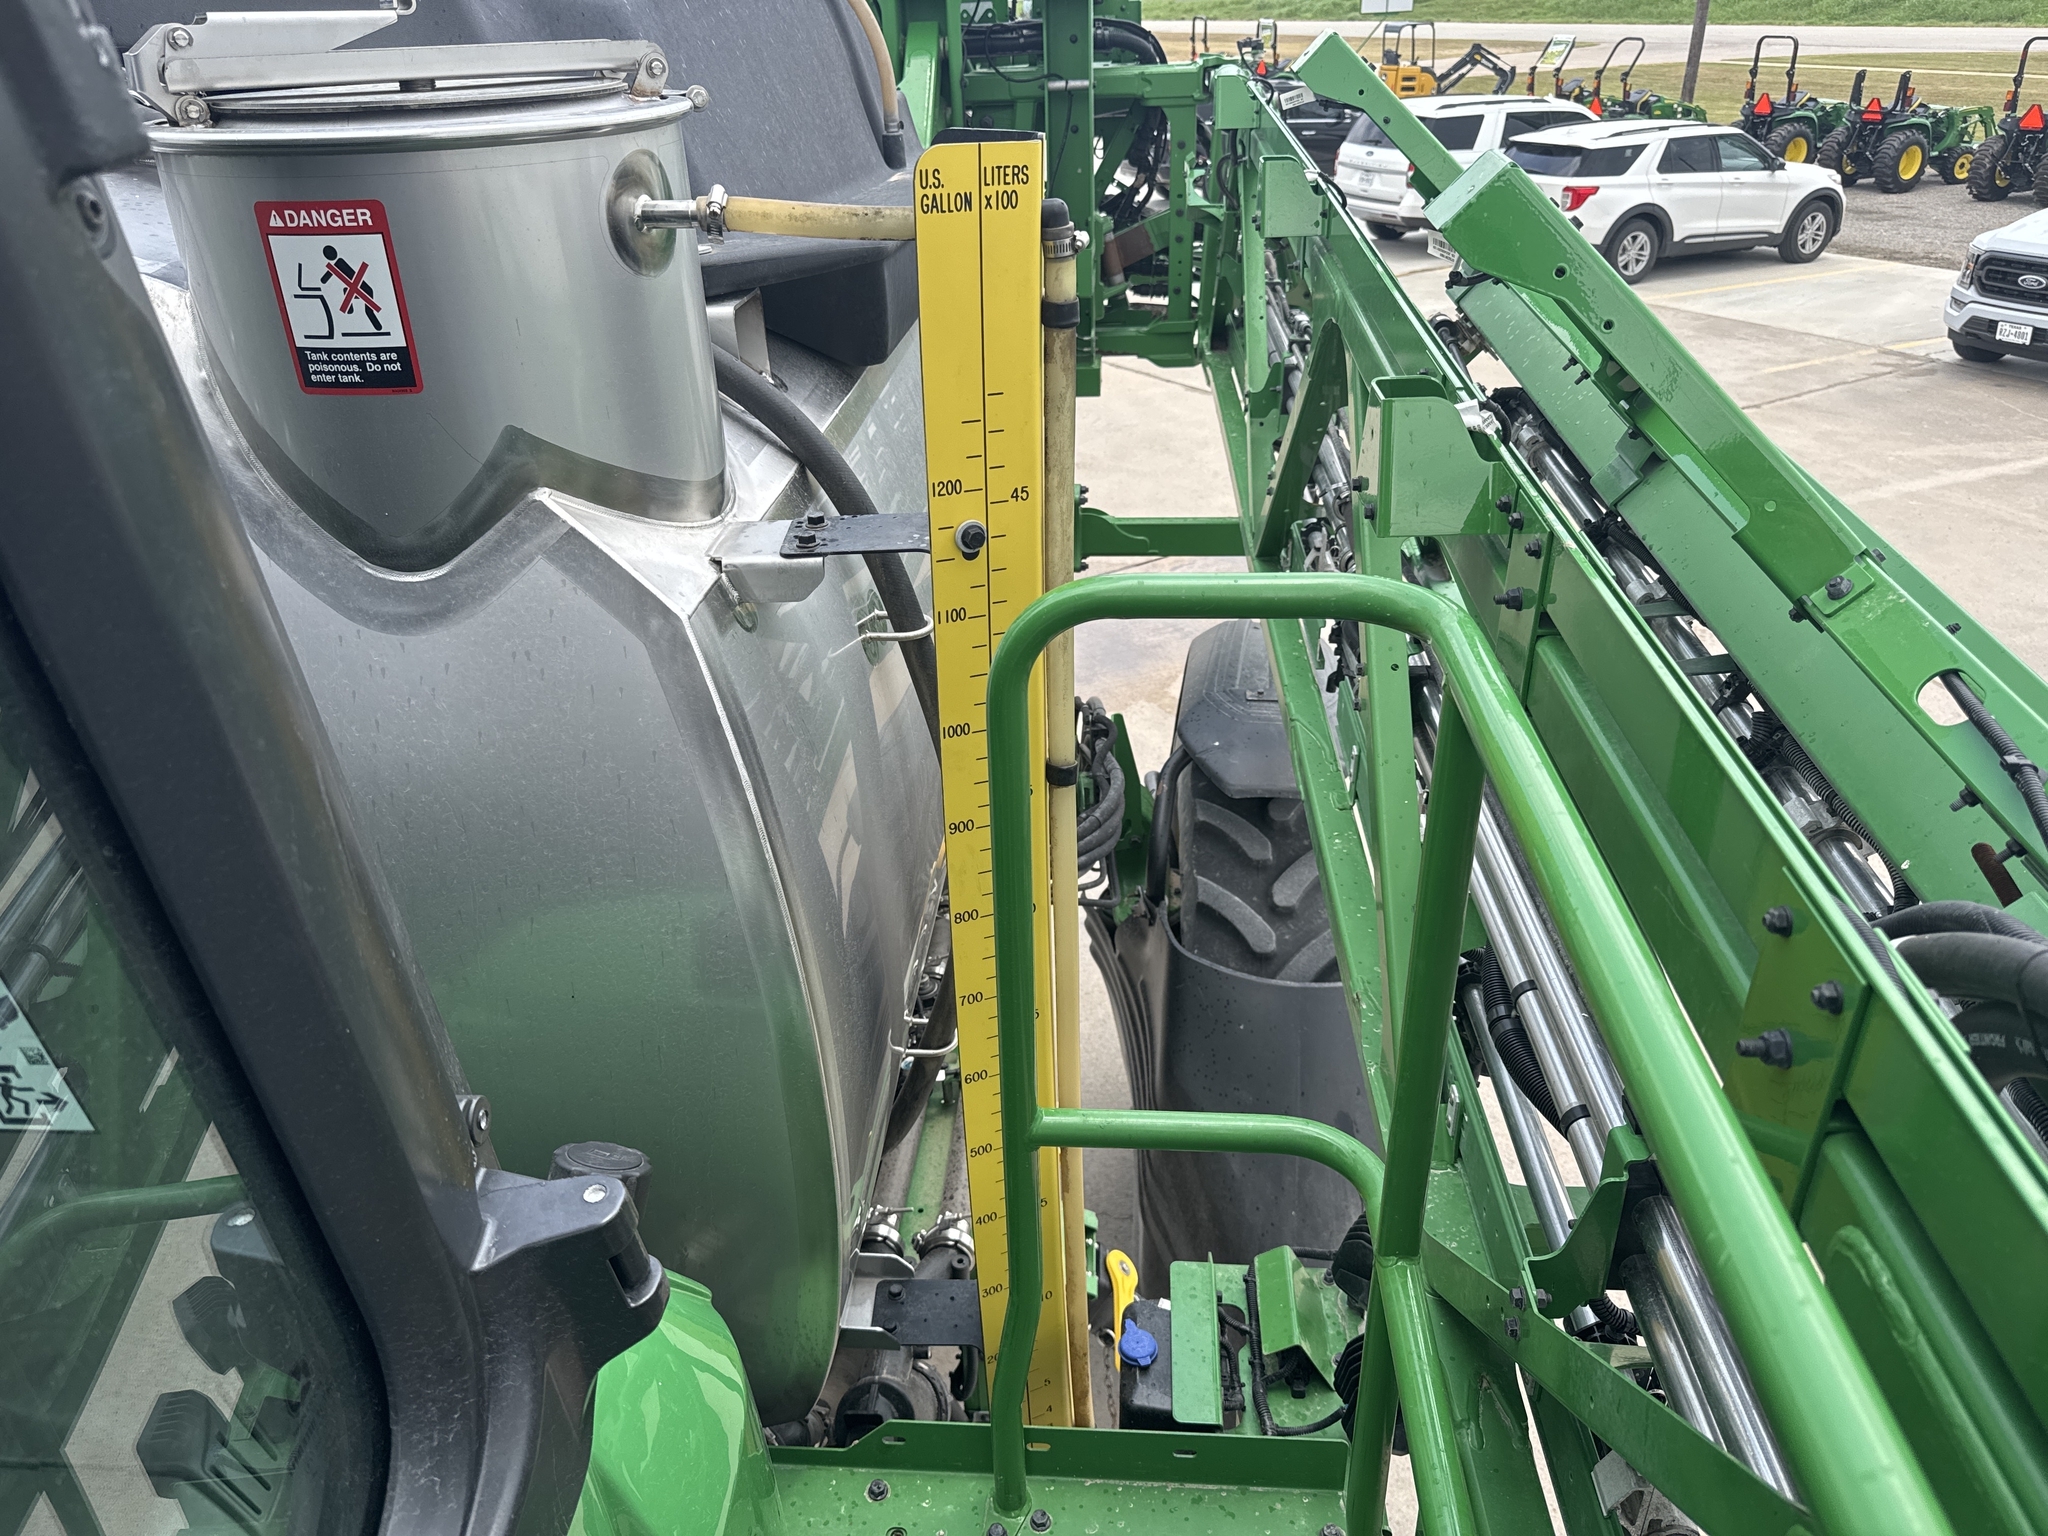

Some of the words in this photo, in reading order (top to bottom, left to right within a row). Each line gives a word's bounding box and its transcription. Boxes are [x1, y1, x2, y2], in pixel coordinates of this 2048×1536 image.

[920, 168, 944, 190] U.S.
[984, 164, 1029, 186] LITERS
[920, 191, 972, 214] GALLON
[984, 190, 1018, 210] x100
[284, 208, 373, 227] DANGER
[304, 350, 329, 361] Tank
[331, 351, 377, 361] contents
[380, 352, 398, 361] are
[308, 363, 362, 373] poisonous.
[366, 362, 381, 372] Do
[384, 361, 402, 371] not
[311, 373, 336, 382] enter
[338, 373, 365, 383] tank.
[932, 479, 963, 497] 1200
[1010, 486, 1029, 502] 45
[938, 607, 966, 625] 1100
[943, 722, 970, 739] 1000
[948, 819, 974, 835] 900
[954, 908, 979, 924] 800
[959, 991, 983, 1007] 700
[964, 1069, 988, 1085] 600
[970, 1143, 993, 1158] 500
[975, 1211, 997, 1226] 400
[982, 1283, 1003, 1298] 300
[1044, 1377, 1051, 1387] 5
[1046, 1404, 1053, 1413] 4
